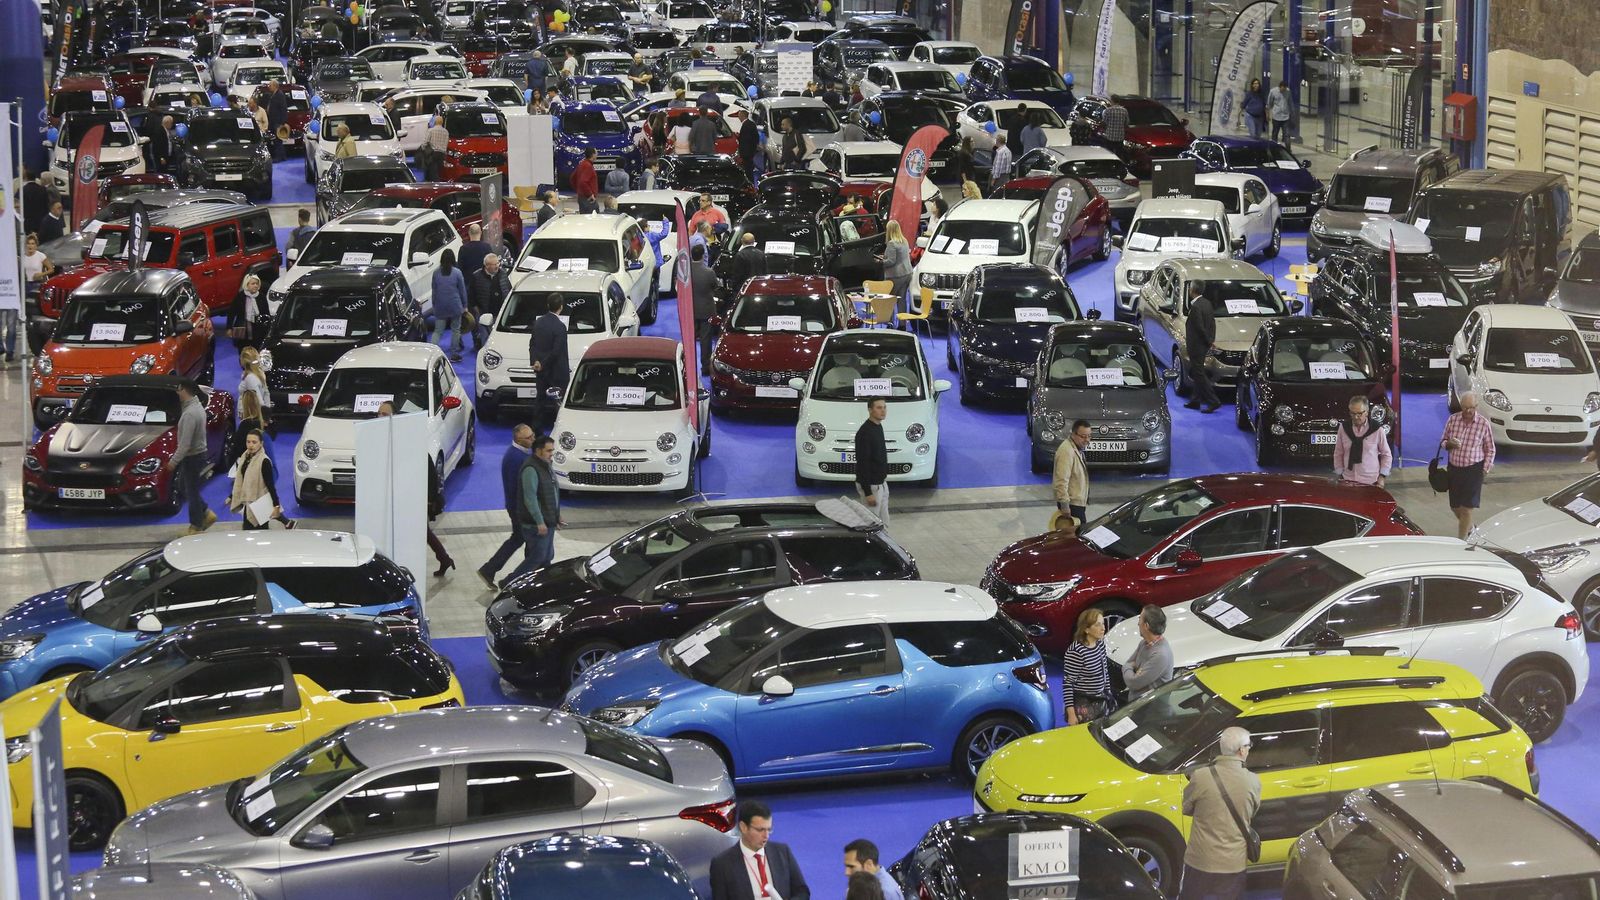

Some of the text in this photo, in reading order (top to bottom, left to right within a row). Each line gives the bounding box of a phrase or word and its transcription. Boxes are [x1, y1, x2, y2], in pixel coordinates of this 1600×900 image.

[1228, 18, 1257, 81] Garum Motor
[1046, 187, 1073, 238] Jeep
[132, 212, 143, 256] Jeep
[1316, 435, 1337, 443] 3903
[1087, 442, 1125, 450] 4339 KNX
[596, 464, 636, 473] 3800 KNY
[65, 490, 103, 498] 4586 JYP
[1024, 842, 1063, 851] OFERTA
[1023, 862, 1049, 876] KM
